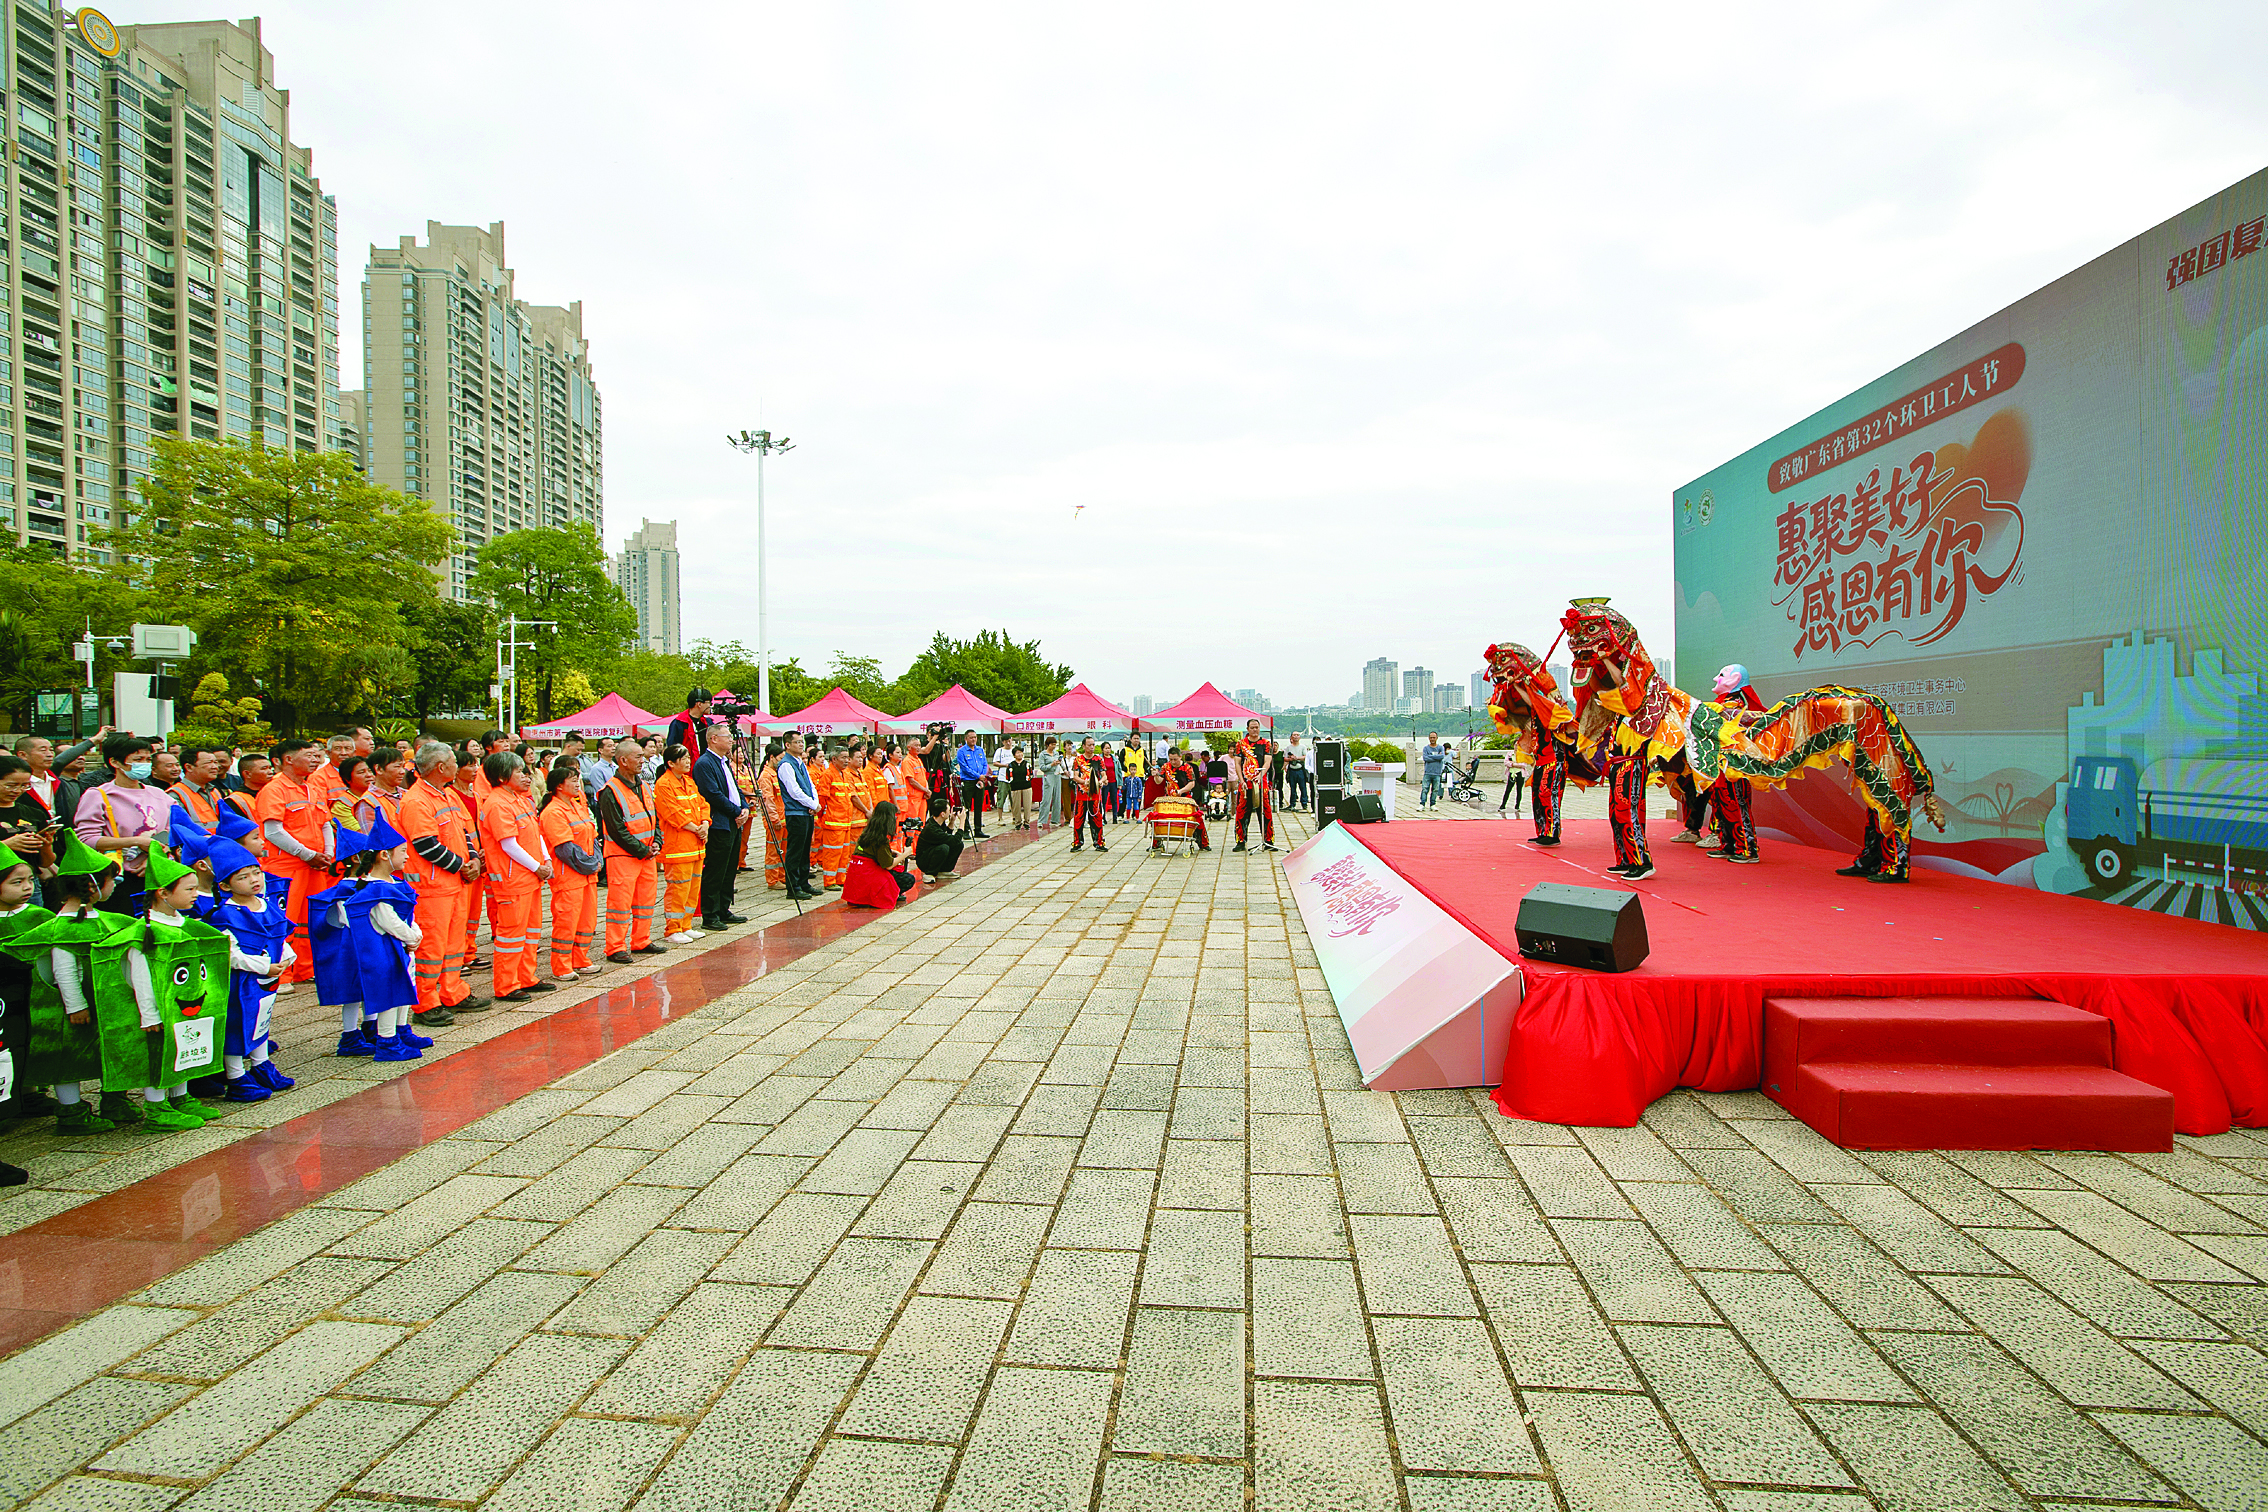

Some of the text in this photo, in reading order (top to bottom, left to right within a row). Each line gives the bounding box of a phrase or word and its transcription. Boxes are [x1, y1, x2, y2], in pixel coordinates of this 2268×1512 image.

[2166, 214, 2268, 291] 强国复
[1779, 359, 2000, 485] 致敬广东省第32个环卫工人节
[1772, 451, 1955, 588] 惠聚美好
[1793, 518, 2010, 660] 感恩有你
[1860, 678, 1965, 697] 市市容环境卫生事务中心
[531, 727, 624, 738] 惠州市第一民医院康复科
[1016, 721, 1055, 730] 口腔健康
[1176, 719, 1233, 730] 测量血压血糖
